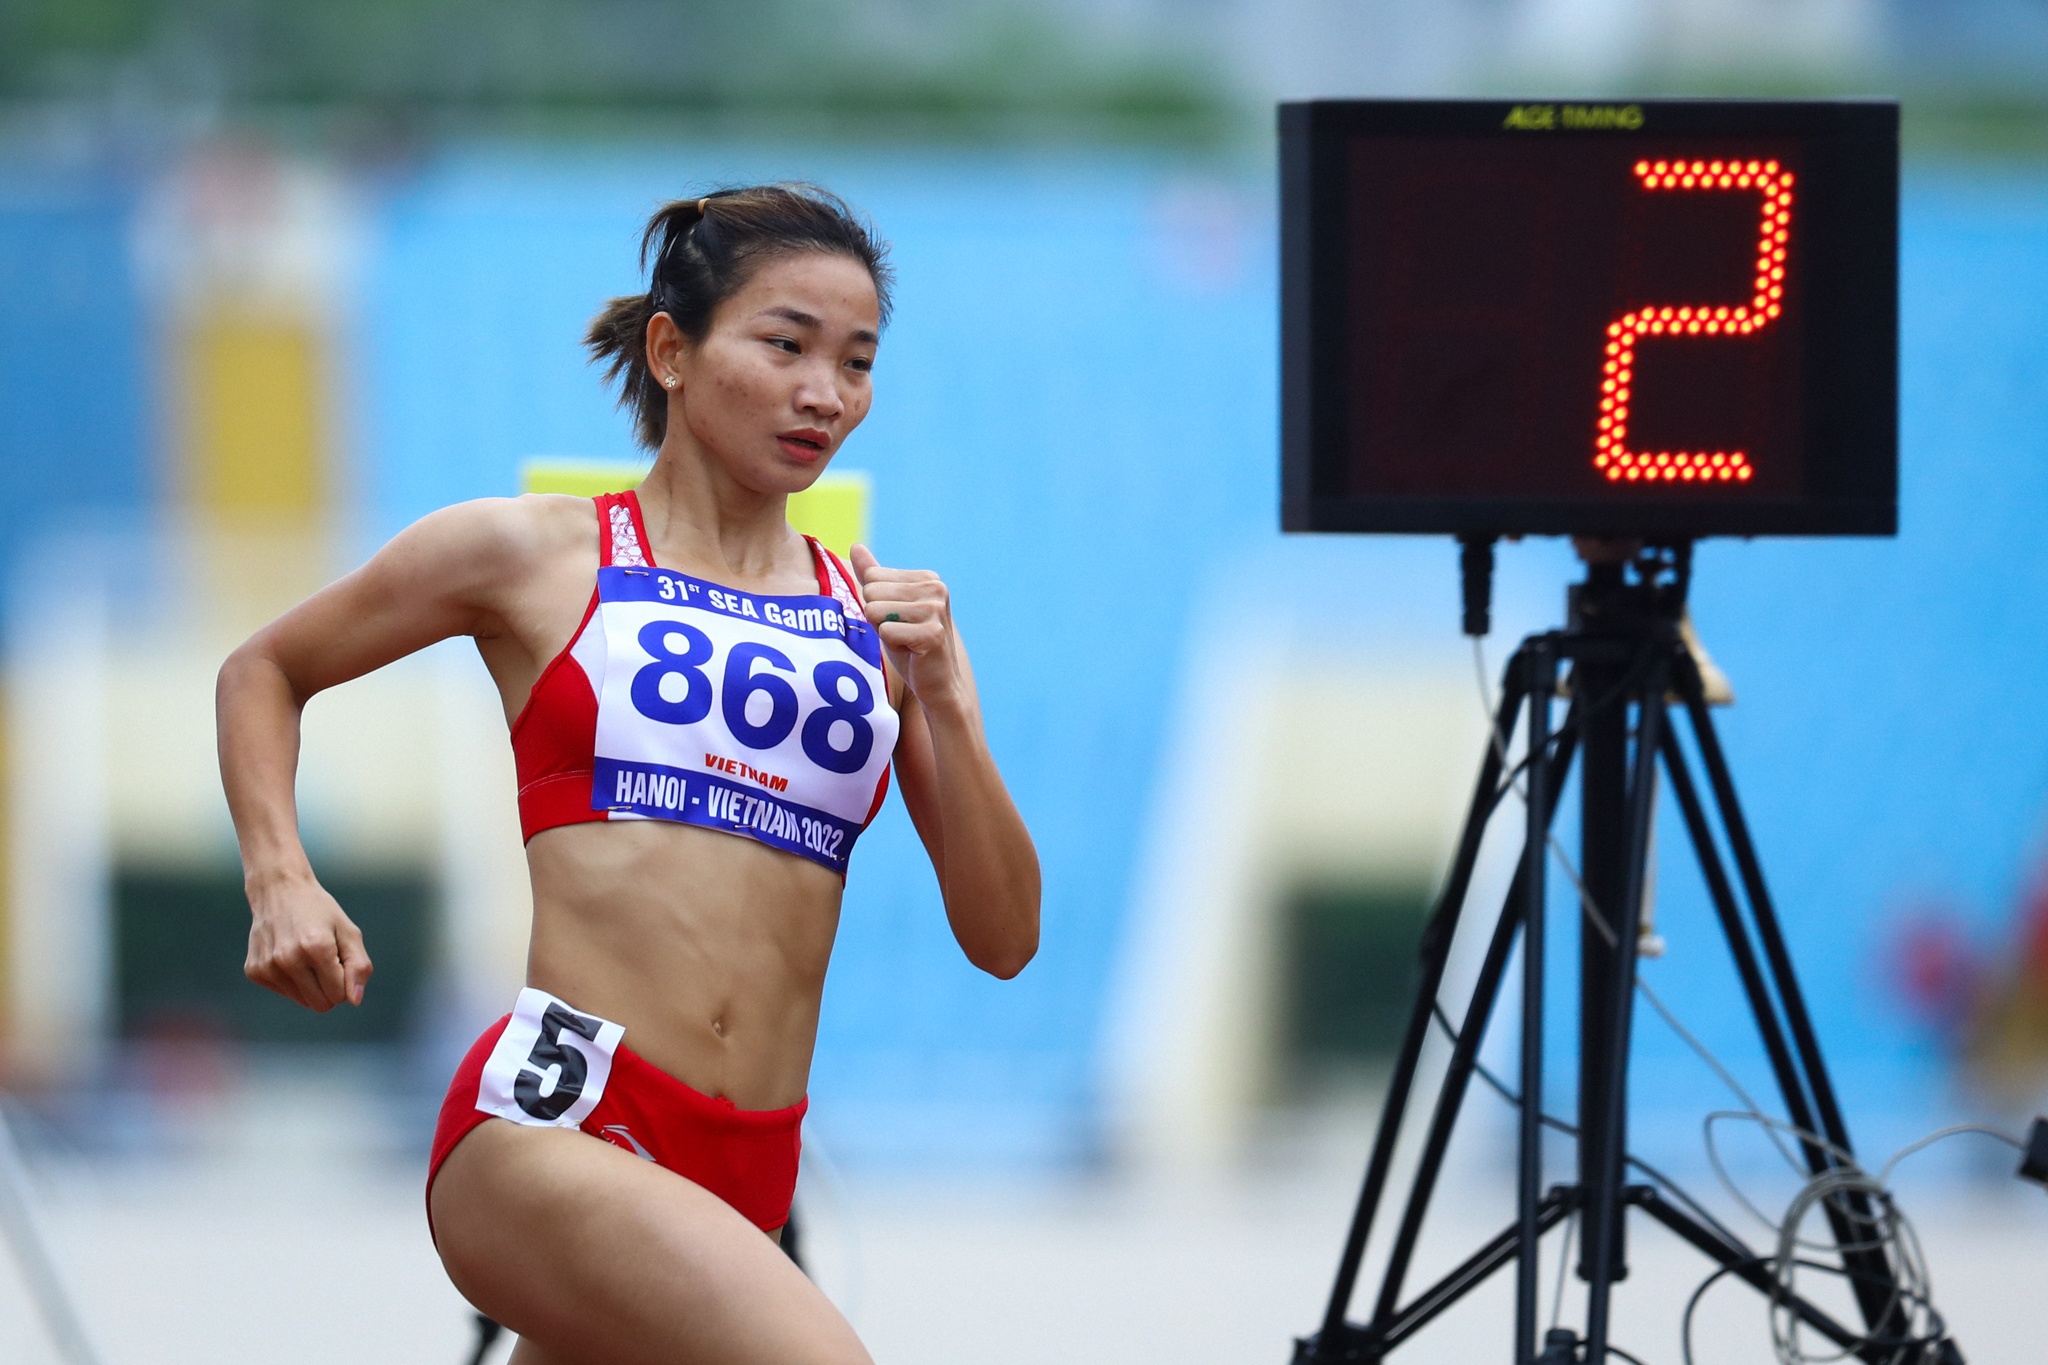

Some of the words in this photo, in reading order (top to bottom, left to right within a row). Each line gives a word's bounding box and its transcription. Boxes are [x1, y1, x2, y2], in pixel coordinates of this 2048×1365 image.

[1594, 159, 1795, 481] 2
[709, 590, 759, 619] SEA
[764, 602, 846, 637] Games
[630, 620, 874, 774] 868
[615, 770, 686, 811] HANOI
[708, 785, 801, 843] VIETNAM
[801, 817, 844, 858] 2022
[705, 753, 788, 792] VIETNAM
[514, 1001, 604, 1120] 5
